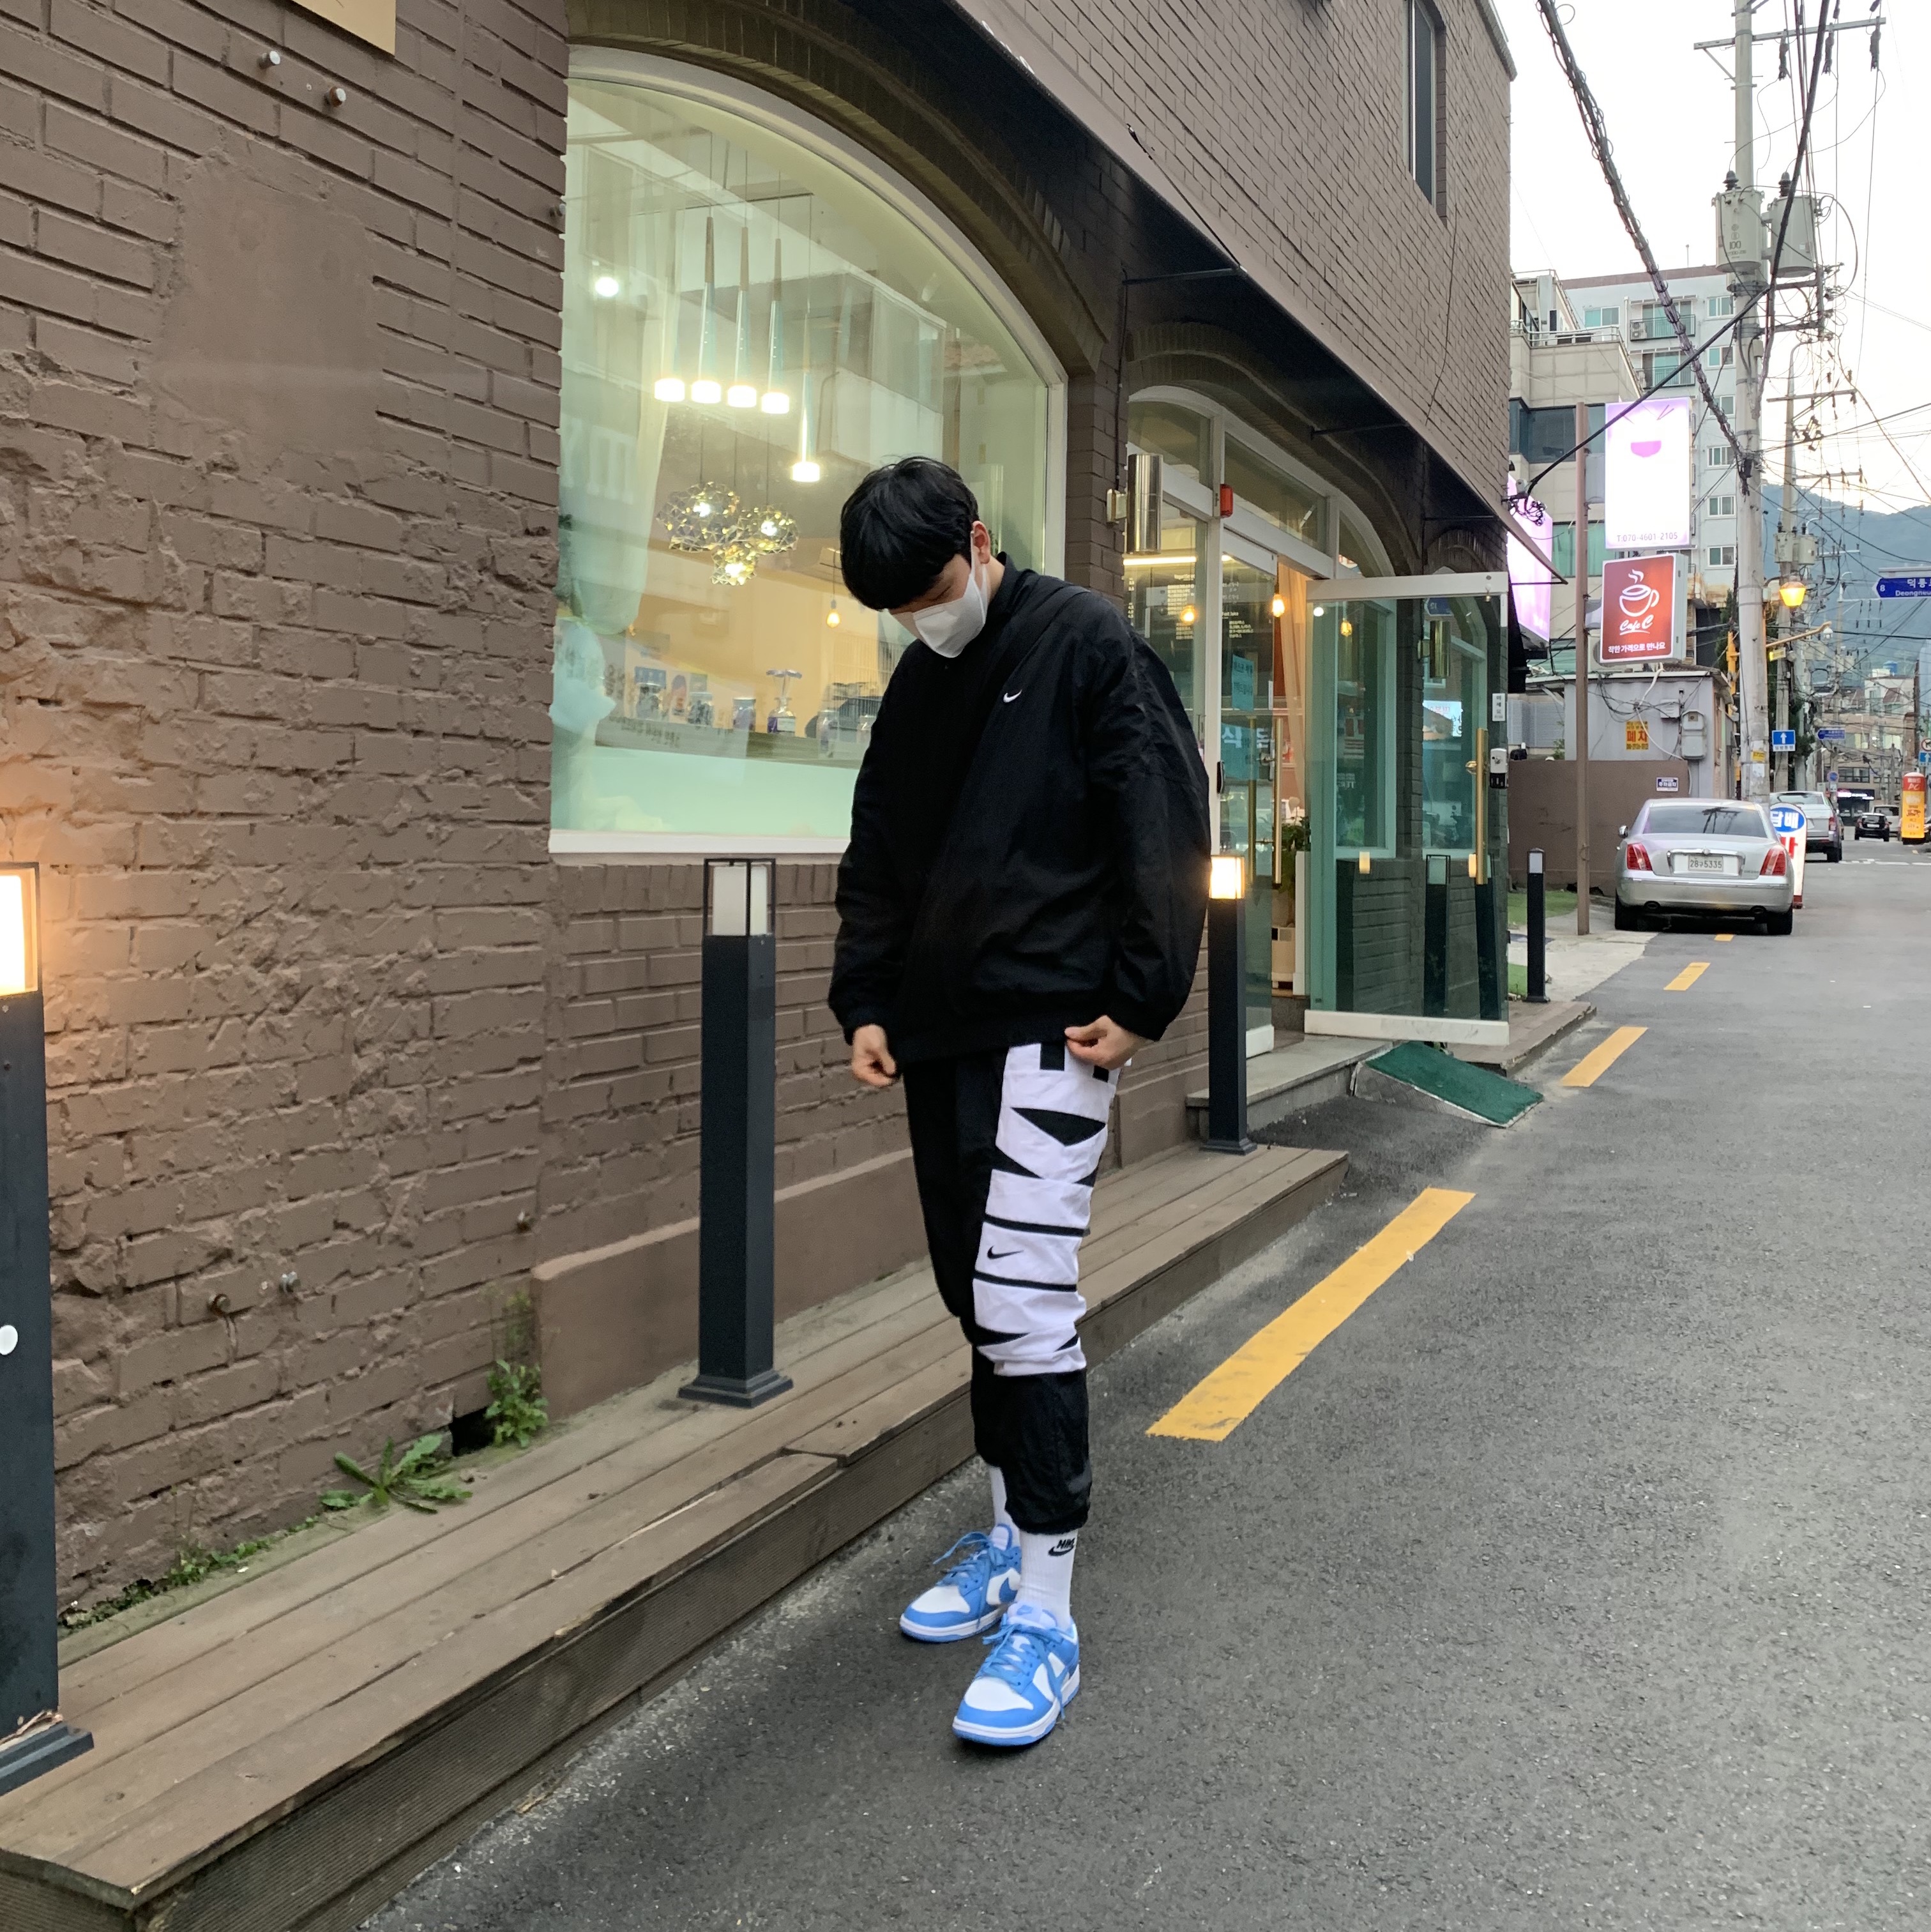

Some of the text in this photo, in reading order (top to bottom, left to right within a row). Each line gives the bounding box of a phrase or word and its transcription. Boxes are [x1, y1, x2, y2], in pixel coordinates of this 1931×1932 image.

[1907, 578, 1931, 588] 덕릉
[1619, 614, 1655, 632] Cafe C
